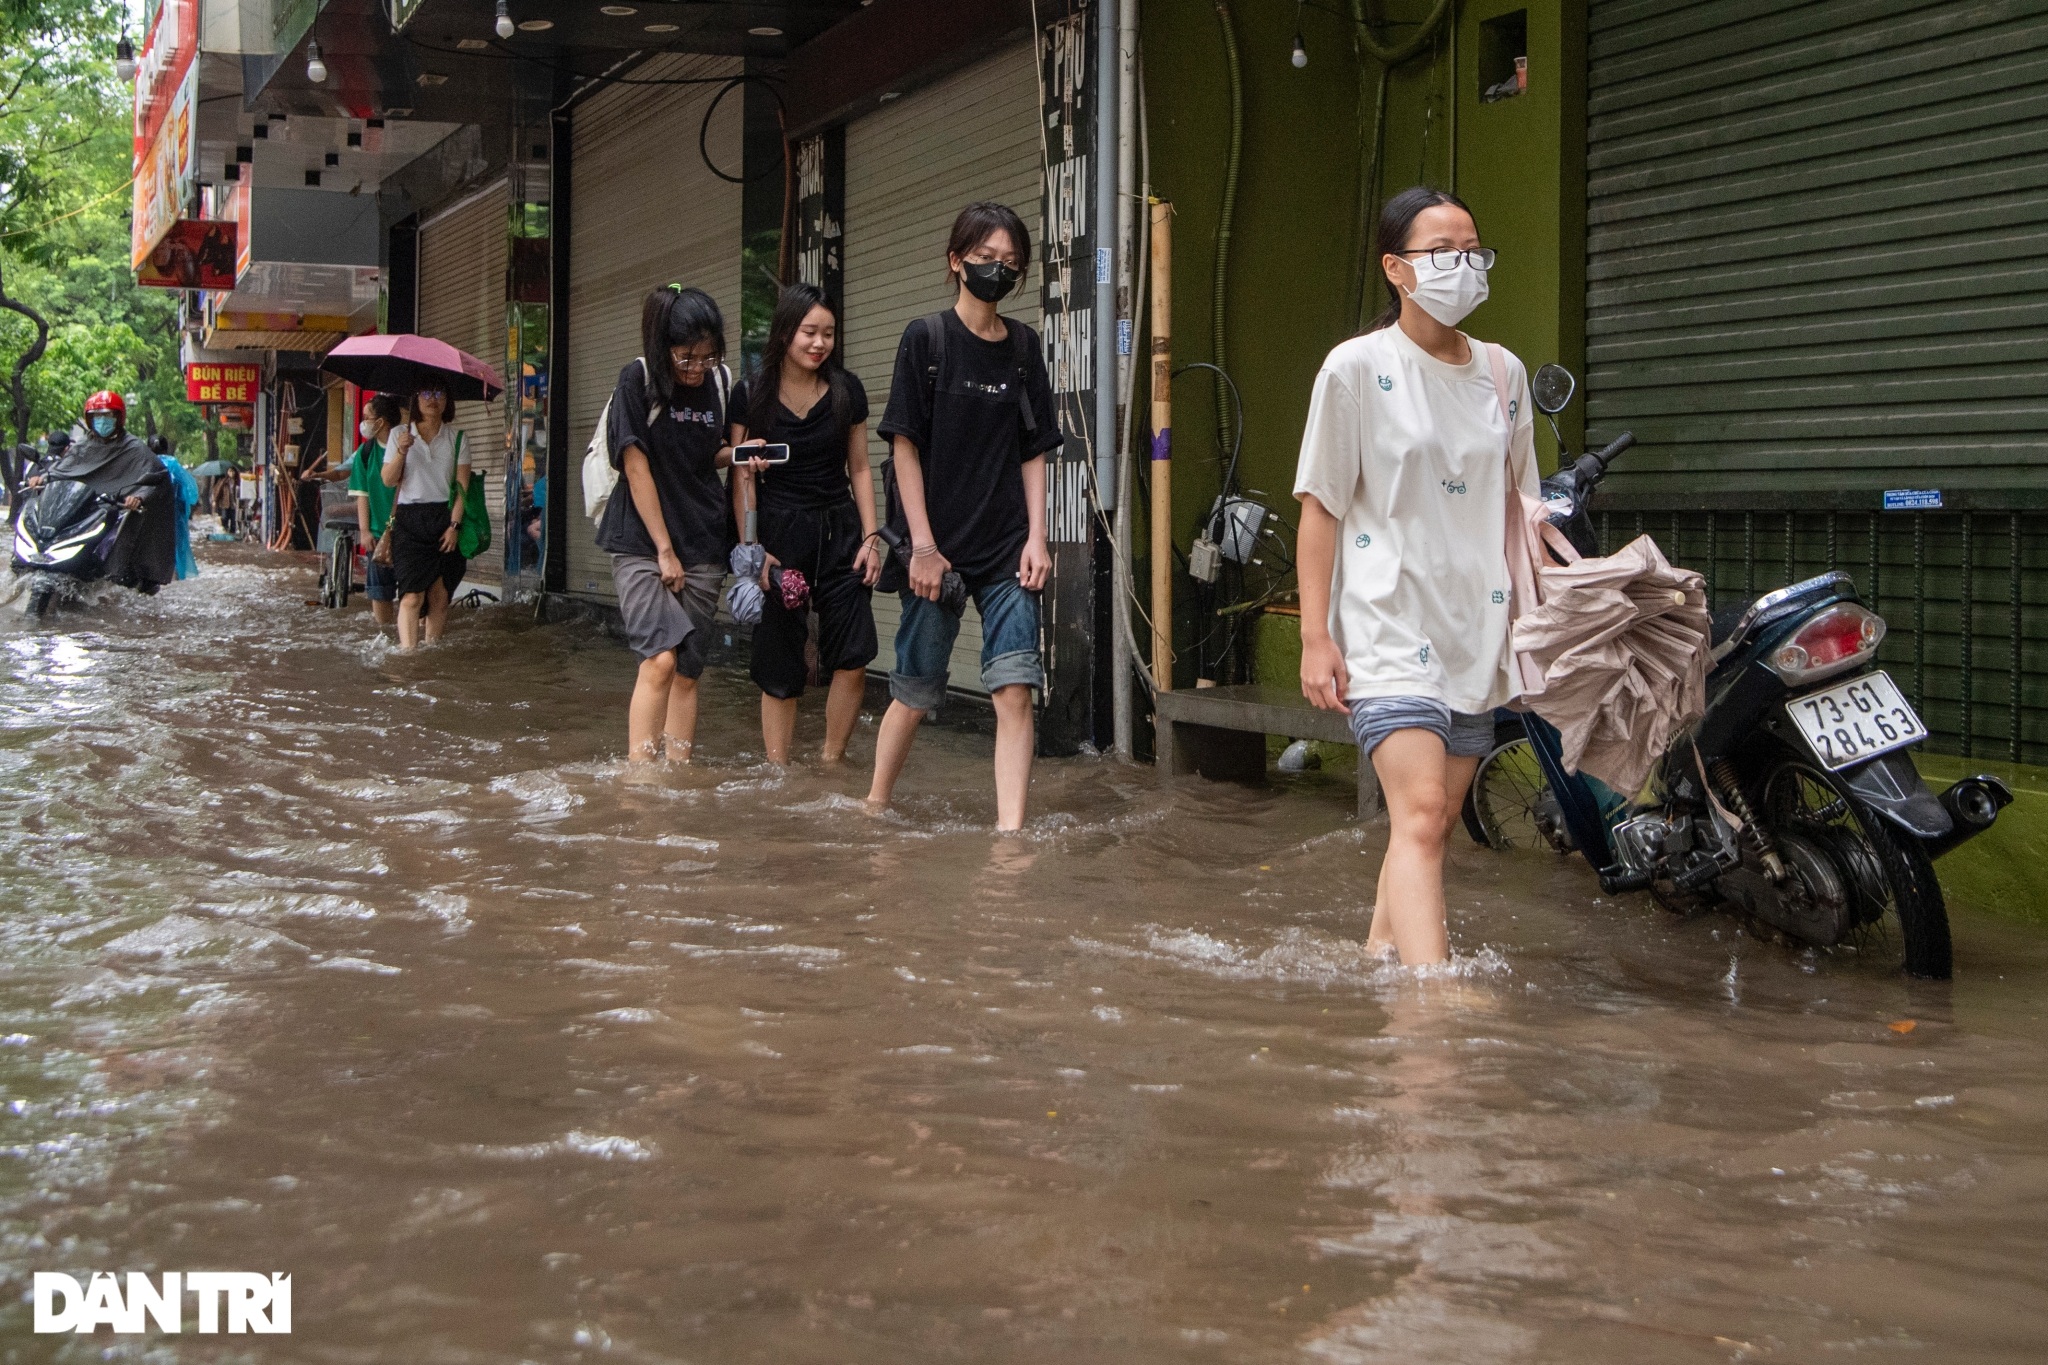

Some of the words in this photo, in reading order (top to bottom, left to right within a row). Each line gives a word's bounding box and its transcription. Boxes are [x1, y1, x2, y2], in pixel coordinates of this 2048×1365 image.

[192, 365, 221, 381] BÚN
[224, 366, 256, 382] RIÊU
[1803, 681, 1884, 729] 73-G1
[1816, 707, 1916, 763] 284.63
